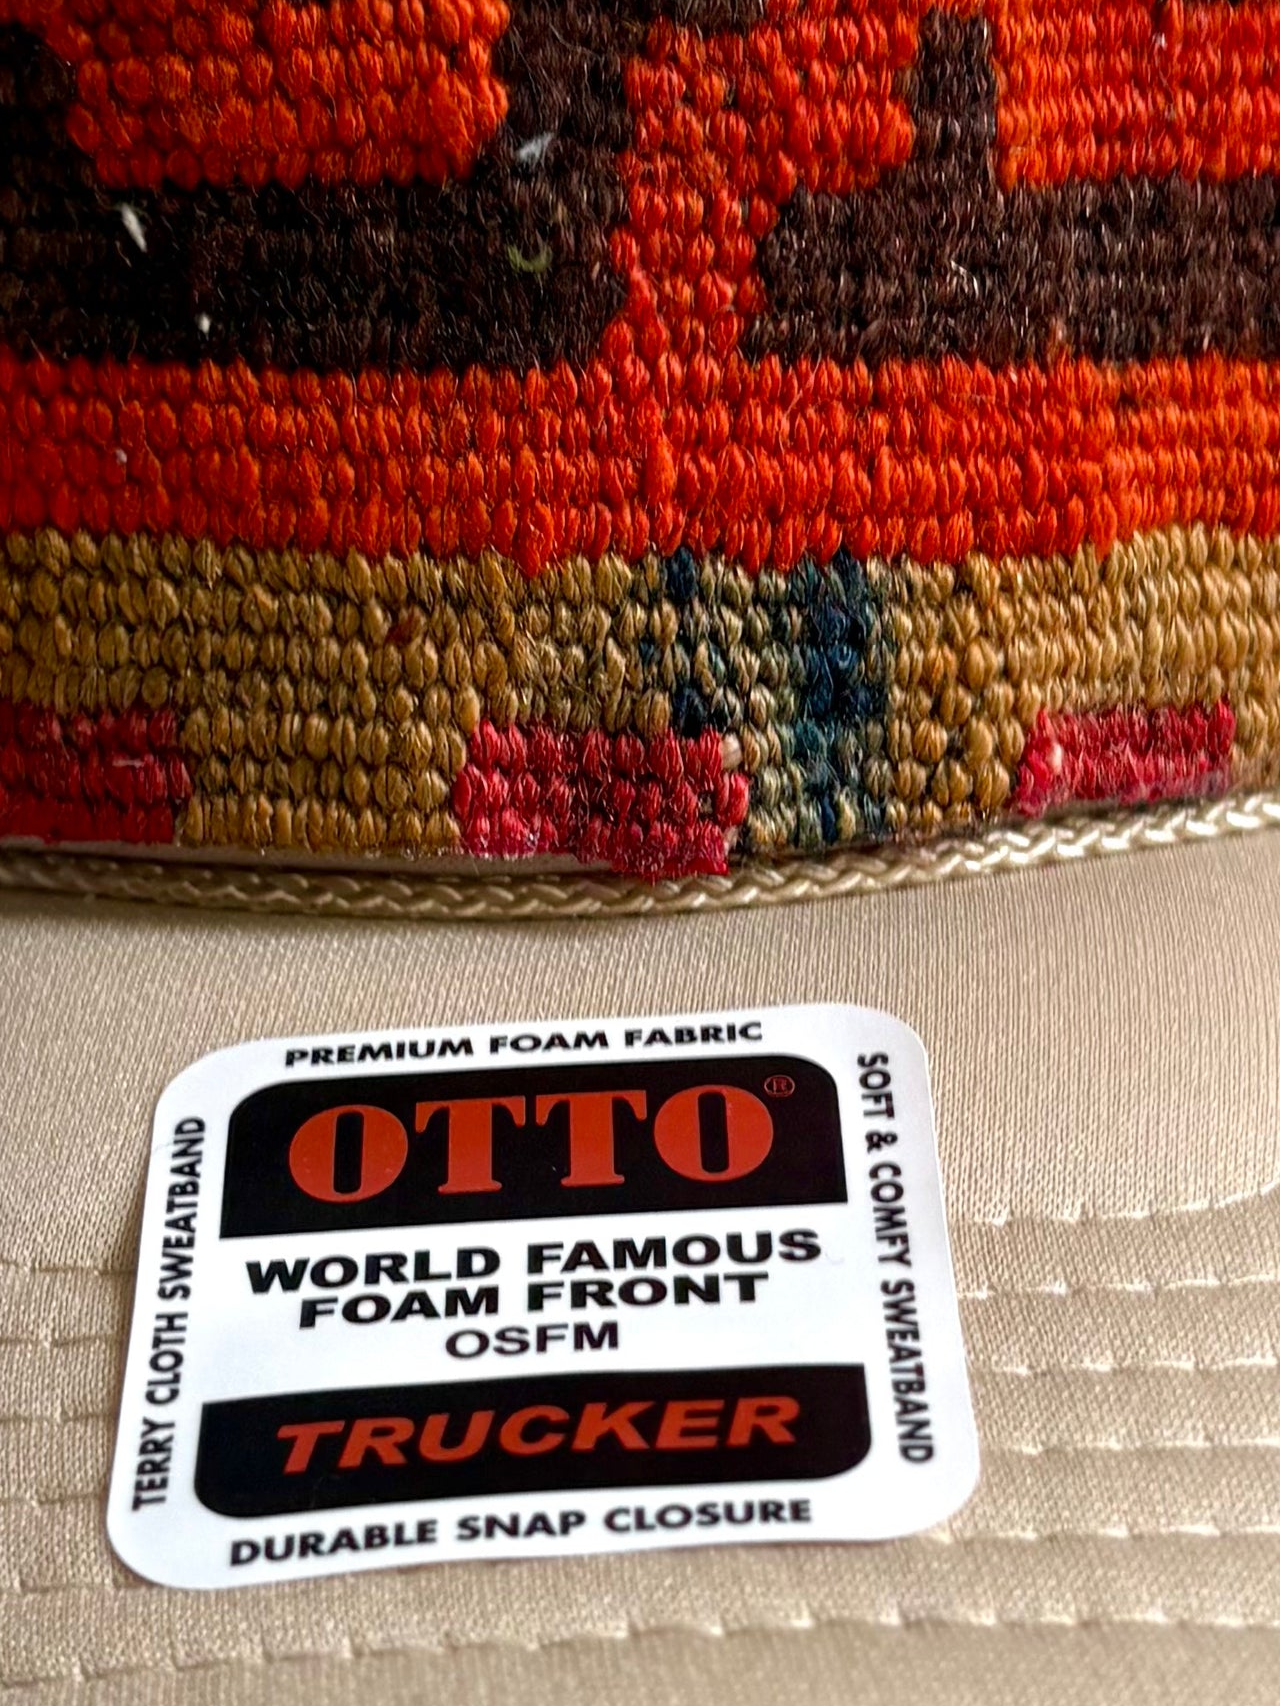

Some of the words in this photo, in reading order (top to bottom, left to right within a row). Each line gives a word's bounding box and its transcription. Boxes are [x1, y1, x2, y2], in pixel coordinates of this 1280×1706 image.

[286, 1039, 473, 1066] PREMIUM
[490, 1032, 608, 1053] FOAM
[625, 1023, 762, 1046] FABRIC
[858, 1052, 894, 1119] SOFT
[865, 1130, 898, 1154] &
[158, 1116, 206, 1299] SWEATBAND
[868, 1160, 912, 1267] COMFY
[246, 1248, 500, 1294] WORLD
[528, 1231, 821, 1274] FAMOUS
[300, 1286, 498, 1328] FOAM
[528, 1273, 768, 1311] FRONT
[146, 1313, 188, 1404] CLOTH
[446, 1322, 618, 1358] OSFM
[880, 1278, 934, 1463] SWEATBAND
[132, 1417, 176, 1511] TERRY
[277, 1396, 800, 1473] TRUCKER
[231, 1521, 436, 1566] DURABLE
[458, 1512, 585, 1540] SNAP
[605, 1501, 809, 1532] CLOSURE
